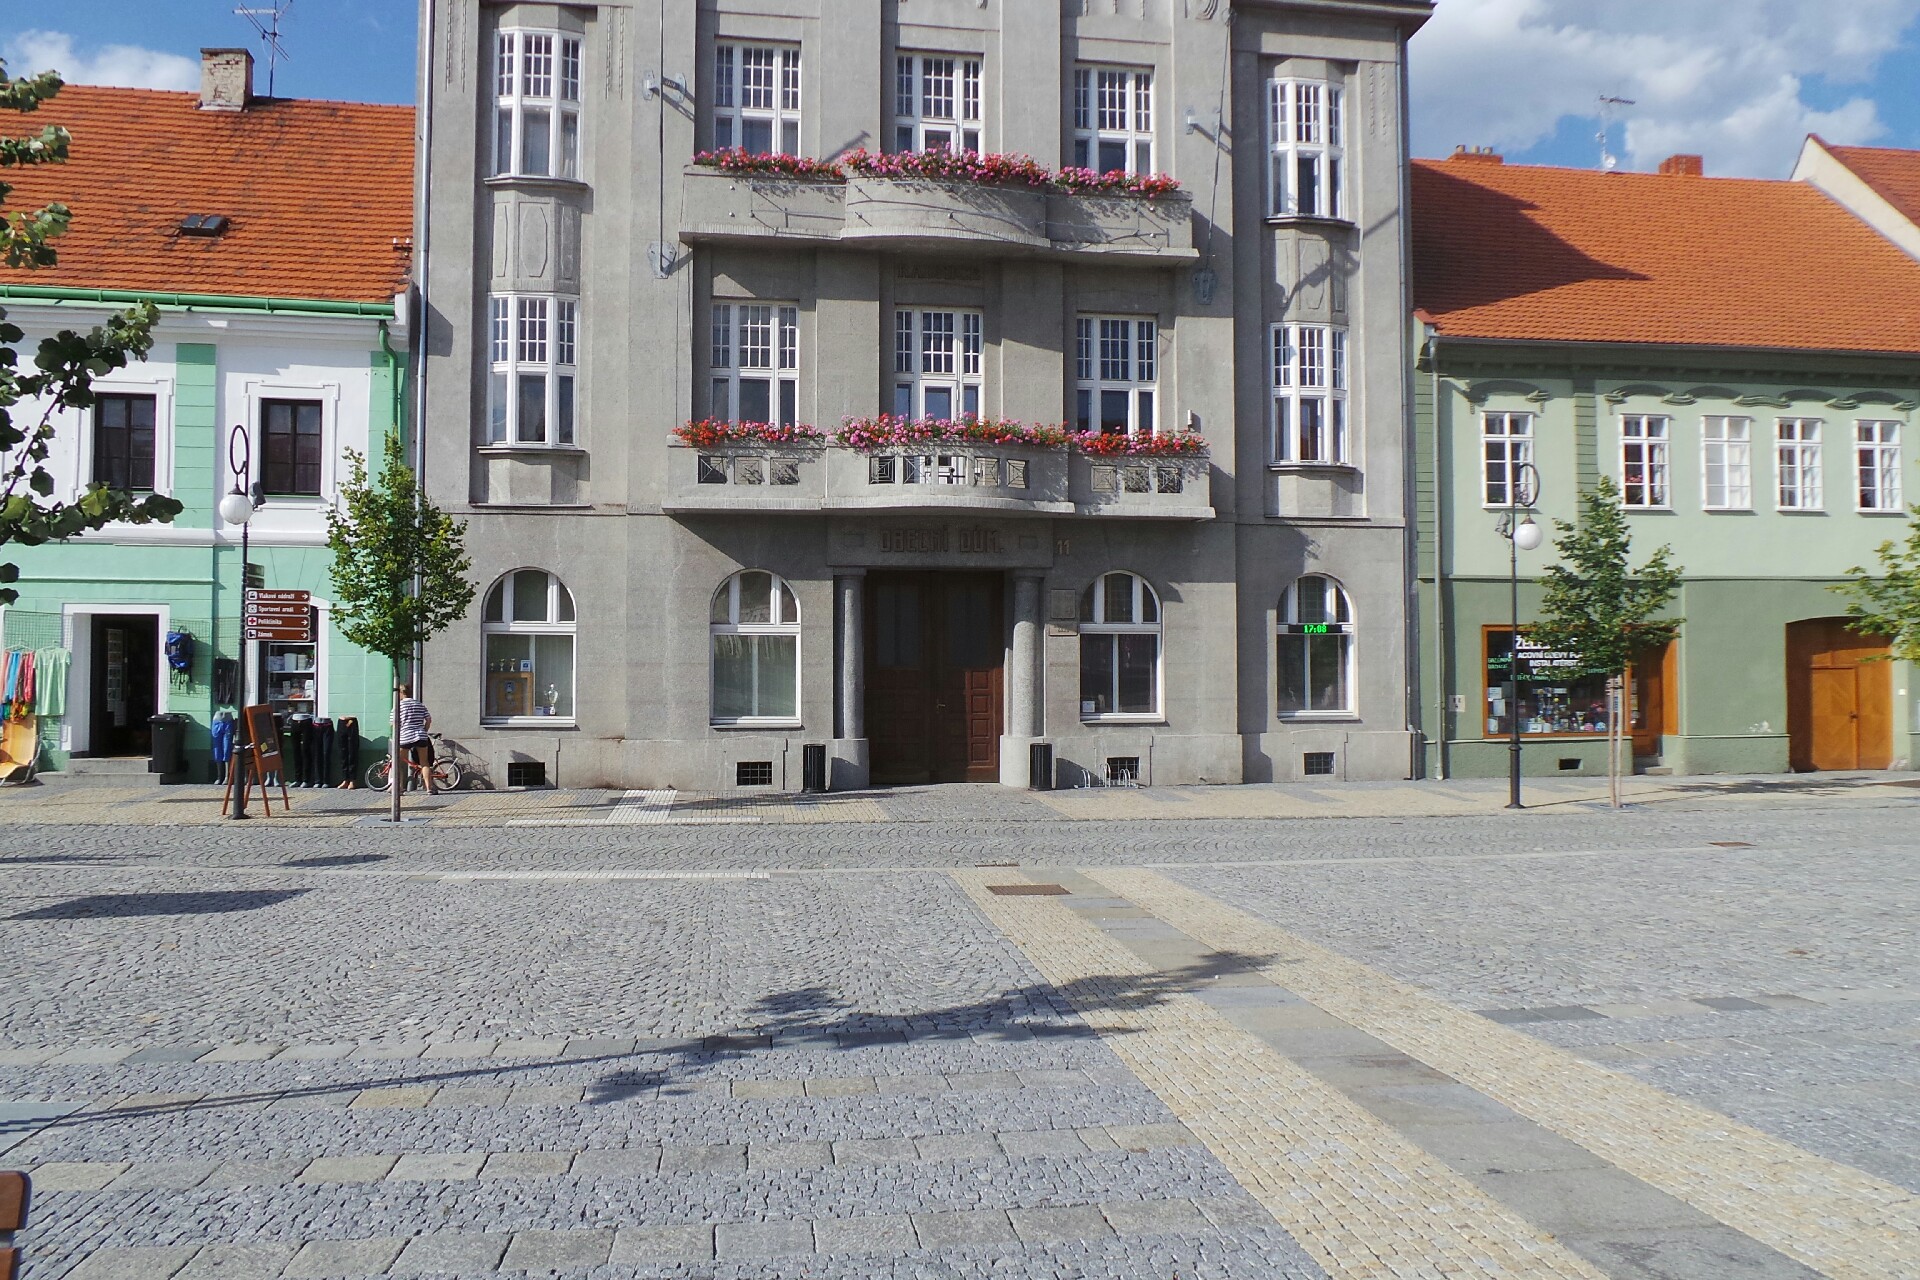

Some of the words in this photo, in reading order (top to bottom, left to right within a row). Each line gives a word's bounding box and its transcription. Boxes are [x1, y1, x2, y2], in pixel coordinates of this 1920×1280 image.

[1057, 539, 1070, 555] 11
[1304, 625, 1327, 633] 17:08
[1508, 650, 1544, 659] PACOVNÍ
